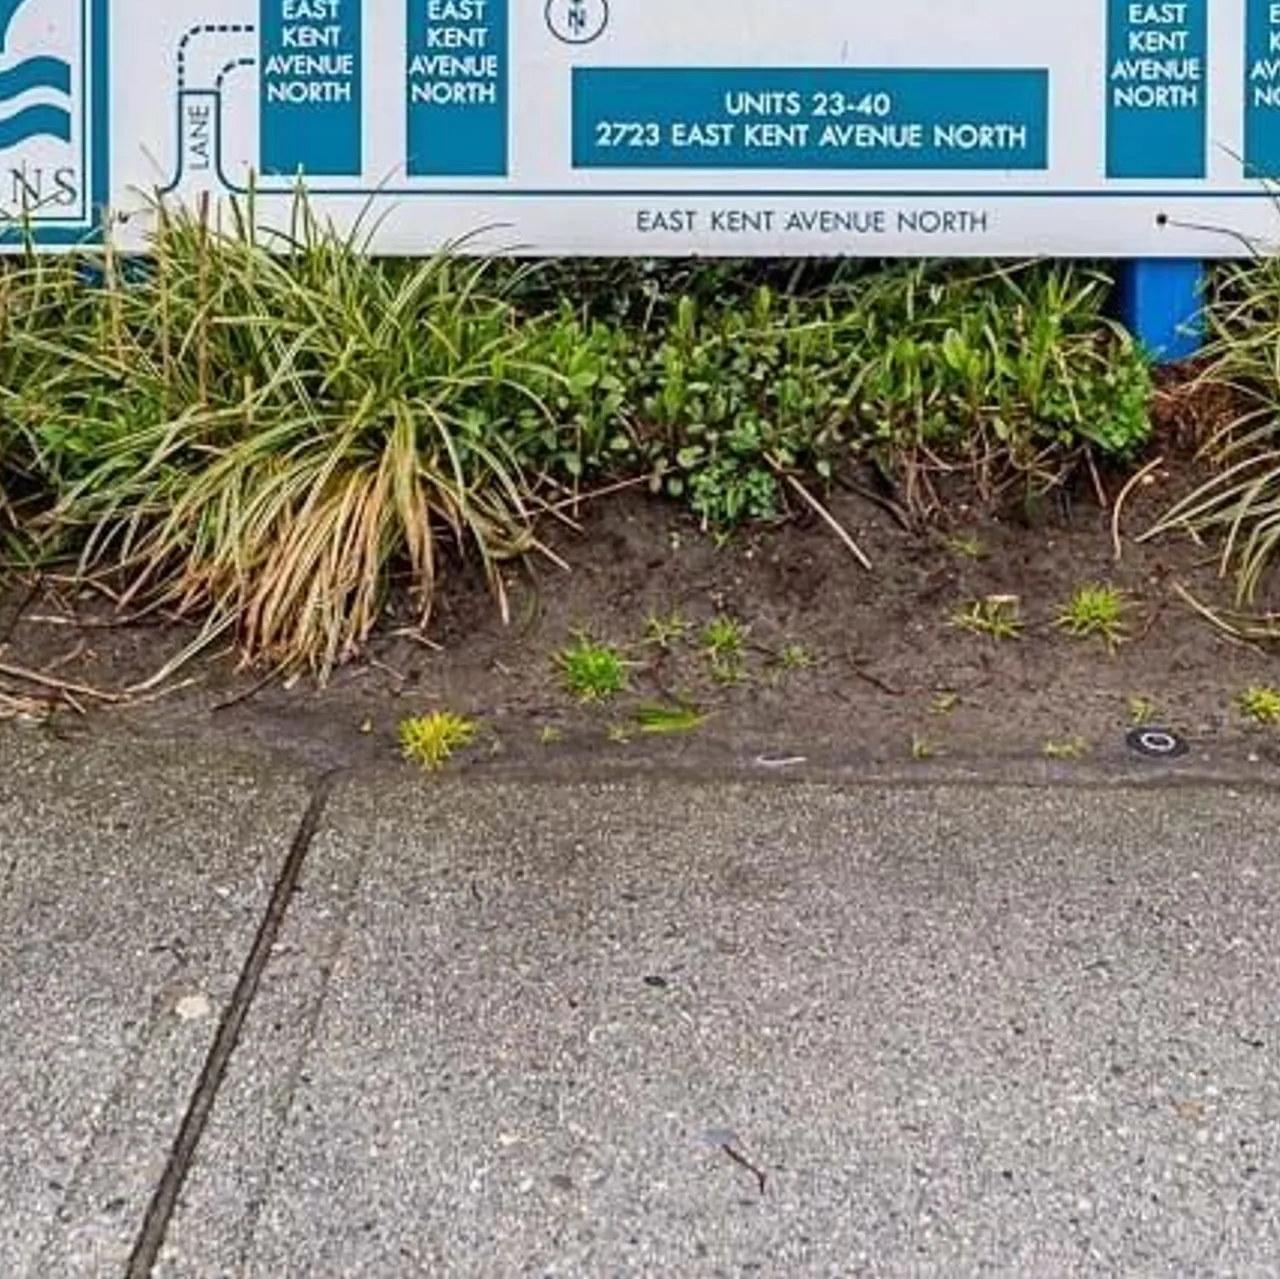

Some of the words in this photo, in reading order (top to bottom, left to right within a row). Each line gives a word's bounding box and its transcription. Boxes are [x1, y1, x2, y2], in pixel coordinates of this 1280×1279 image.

[428, 0, 486, 20] EAST
[1129, 4, 1188, 23] EAST
[282, 26, 340, 48] KENT
[427, 27, 488, 48] KENT
[1129, 31, 1189, 52] KENT
[265, 54, 354, 75] AVENUE
[409, 54, 498, 77] AVENUE
[1111, 59, 1201, 80] AVENUE
[267, 82, 350, 103] NORTH
[411, 83, 495, 104] NORTH
[1113, 85, 1198, 108] NORTH
[724, 92, 800, 116] UNITS
[811, 93, 891, 116] 23-40
[189, 105, 209, 171] LANE
[595, 122, 660, 146] 2723
[671, 123, 733, 147] EAST
[744, 124, 809, 148] KENT
[820, 124, 921, 148] AVENUE
[934, 125, 1026, 149] NORTH
[636, 211, 697, 232] EAST
[711, 211, 774, 232] KENT
[786, 211, 886, 233] AVENUE
[897, 211, 988, 233] NORTH
